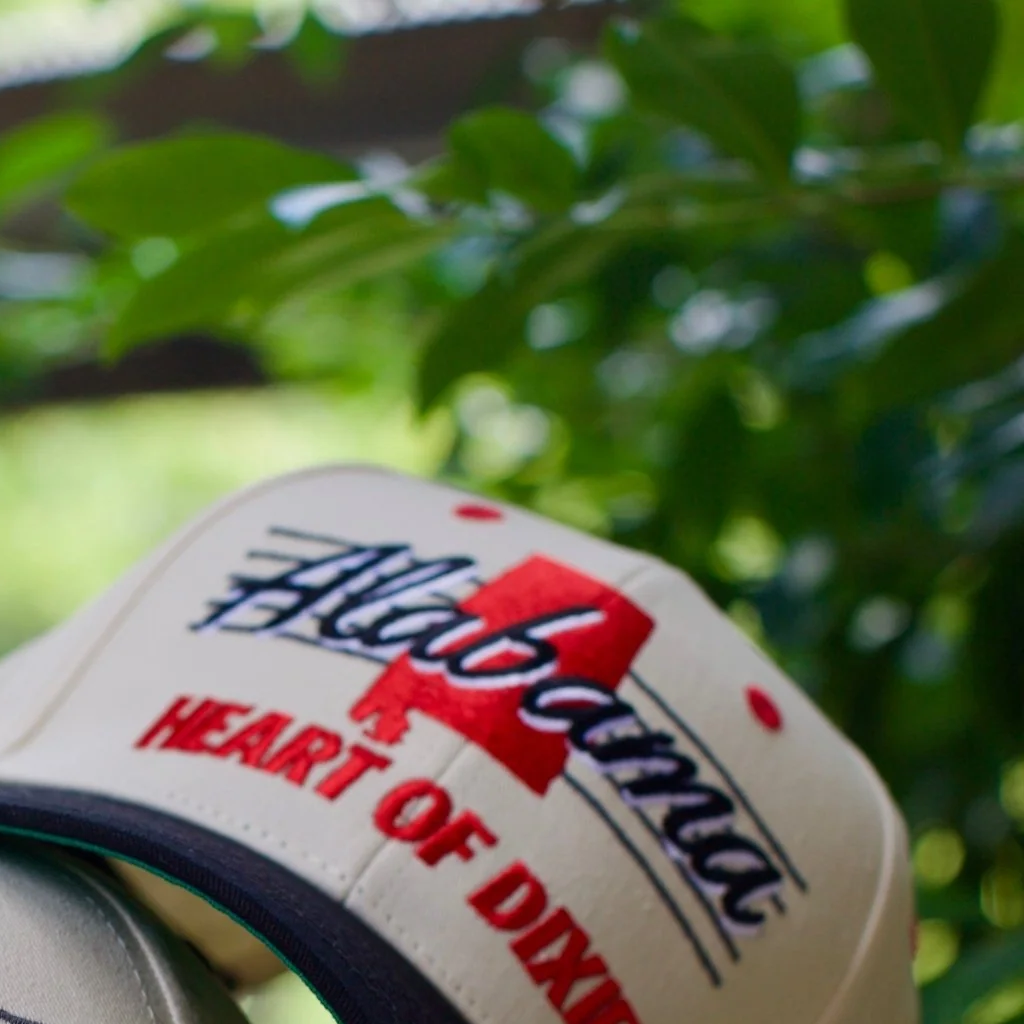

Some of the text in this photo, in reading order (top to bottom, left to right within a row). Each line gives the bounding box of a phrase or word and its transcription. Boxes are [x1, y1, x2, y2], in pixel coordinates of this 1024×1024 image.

[134, 693, 392, 803] HEART
[370, 777, 499, 868] OF
[196, 541, 783, 939] Alabama
